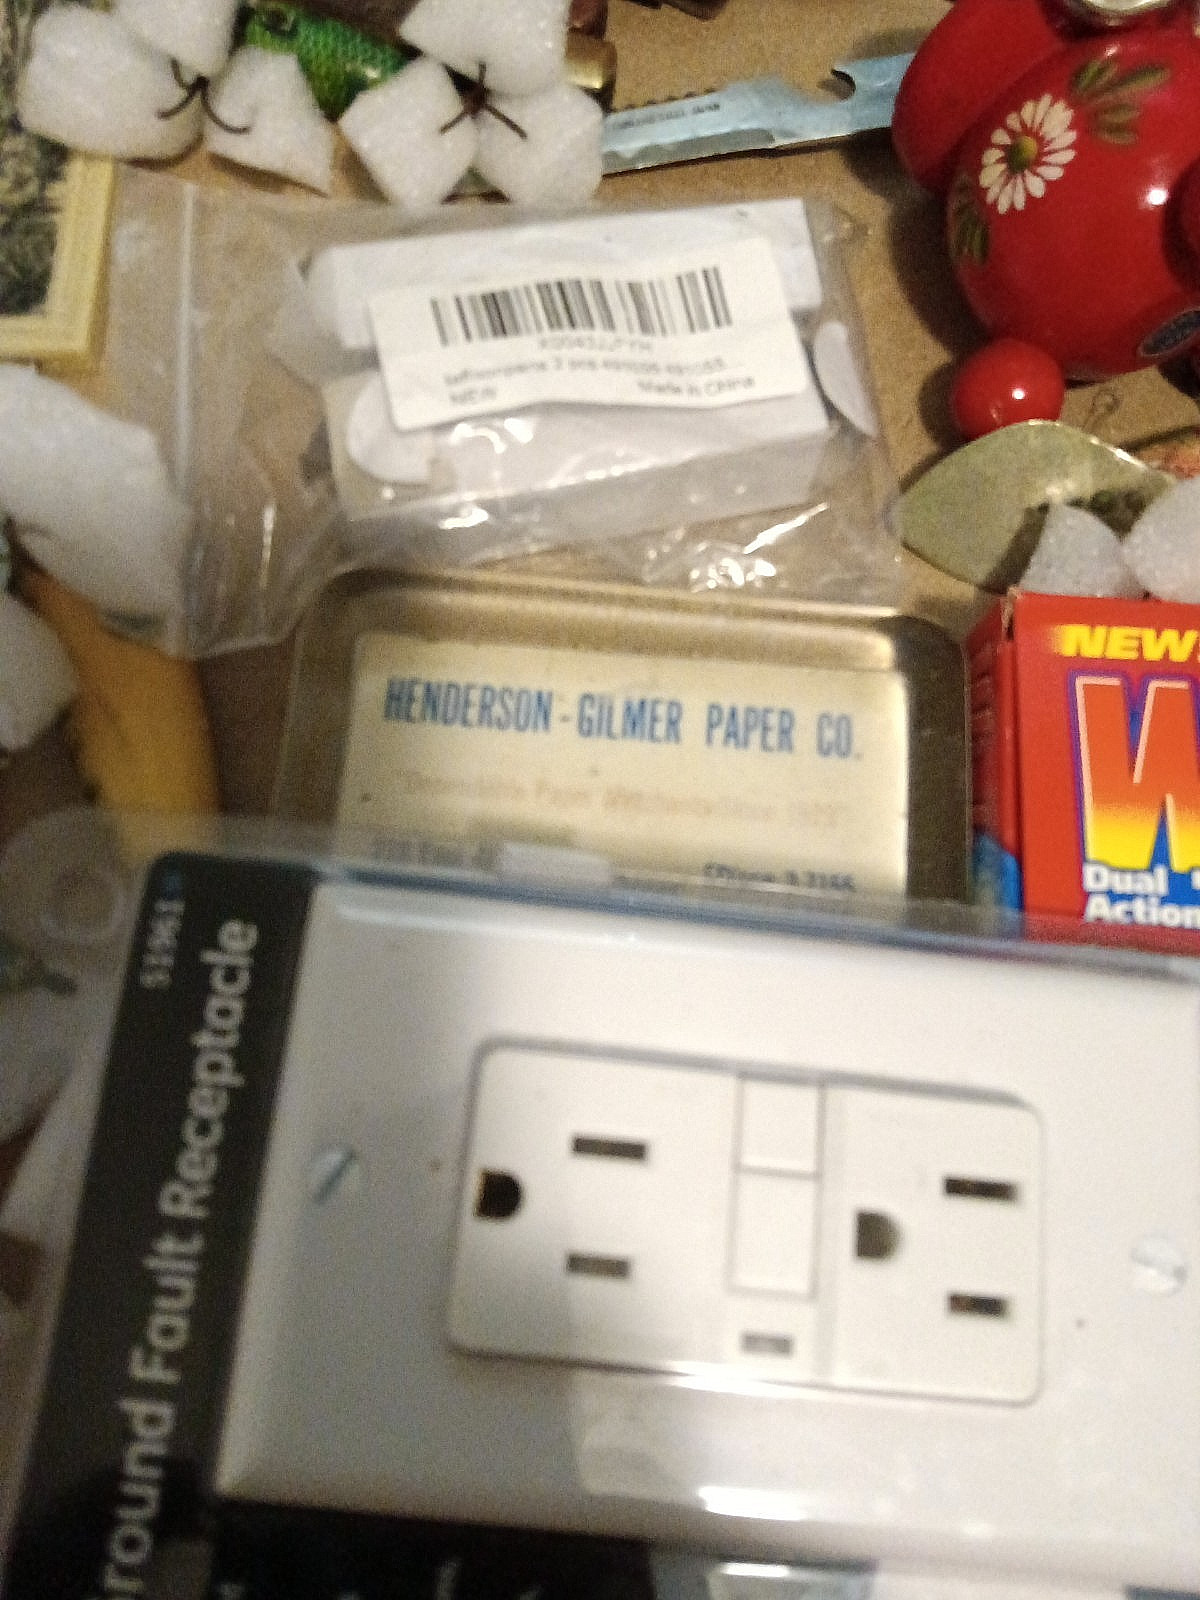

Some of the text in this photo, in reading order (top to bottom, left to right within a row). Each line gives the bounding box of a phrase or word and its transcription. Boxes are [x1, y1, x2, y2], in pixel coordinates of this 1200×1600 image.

[705, 702, 795, 754] PAPER
[815, 712, 863, 761] CO.
[1083, 862, 1168, 896] Dual
[1083, 892, 1200, 930] Action
[157, 917, 260, 1219] Receptacle
[129, 1234, 206, 1385] Fault
[86, 1396, 177, 1600] round
